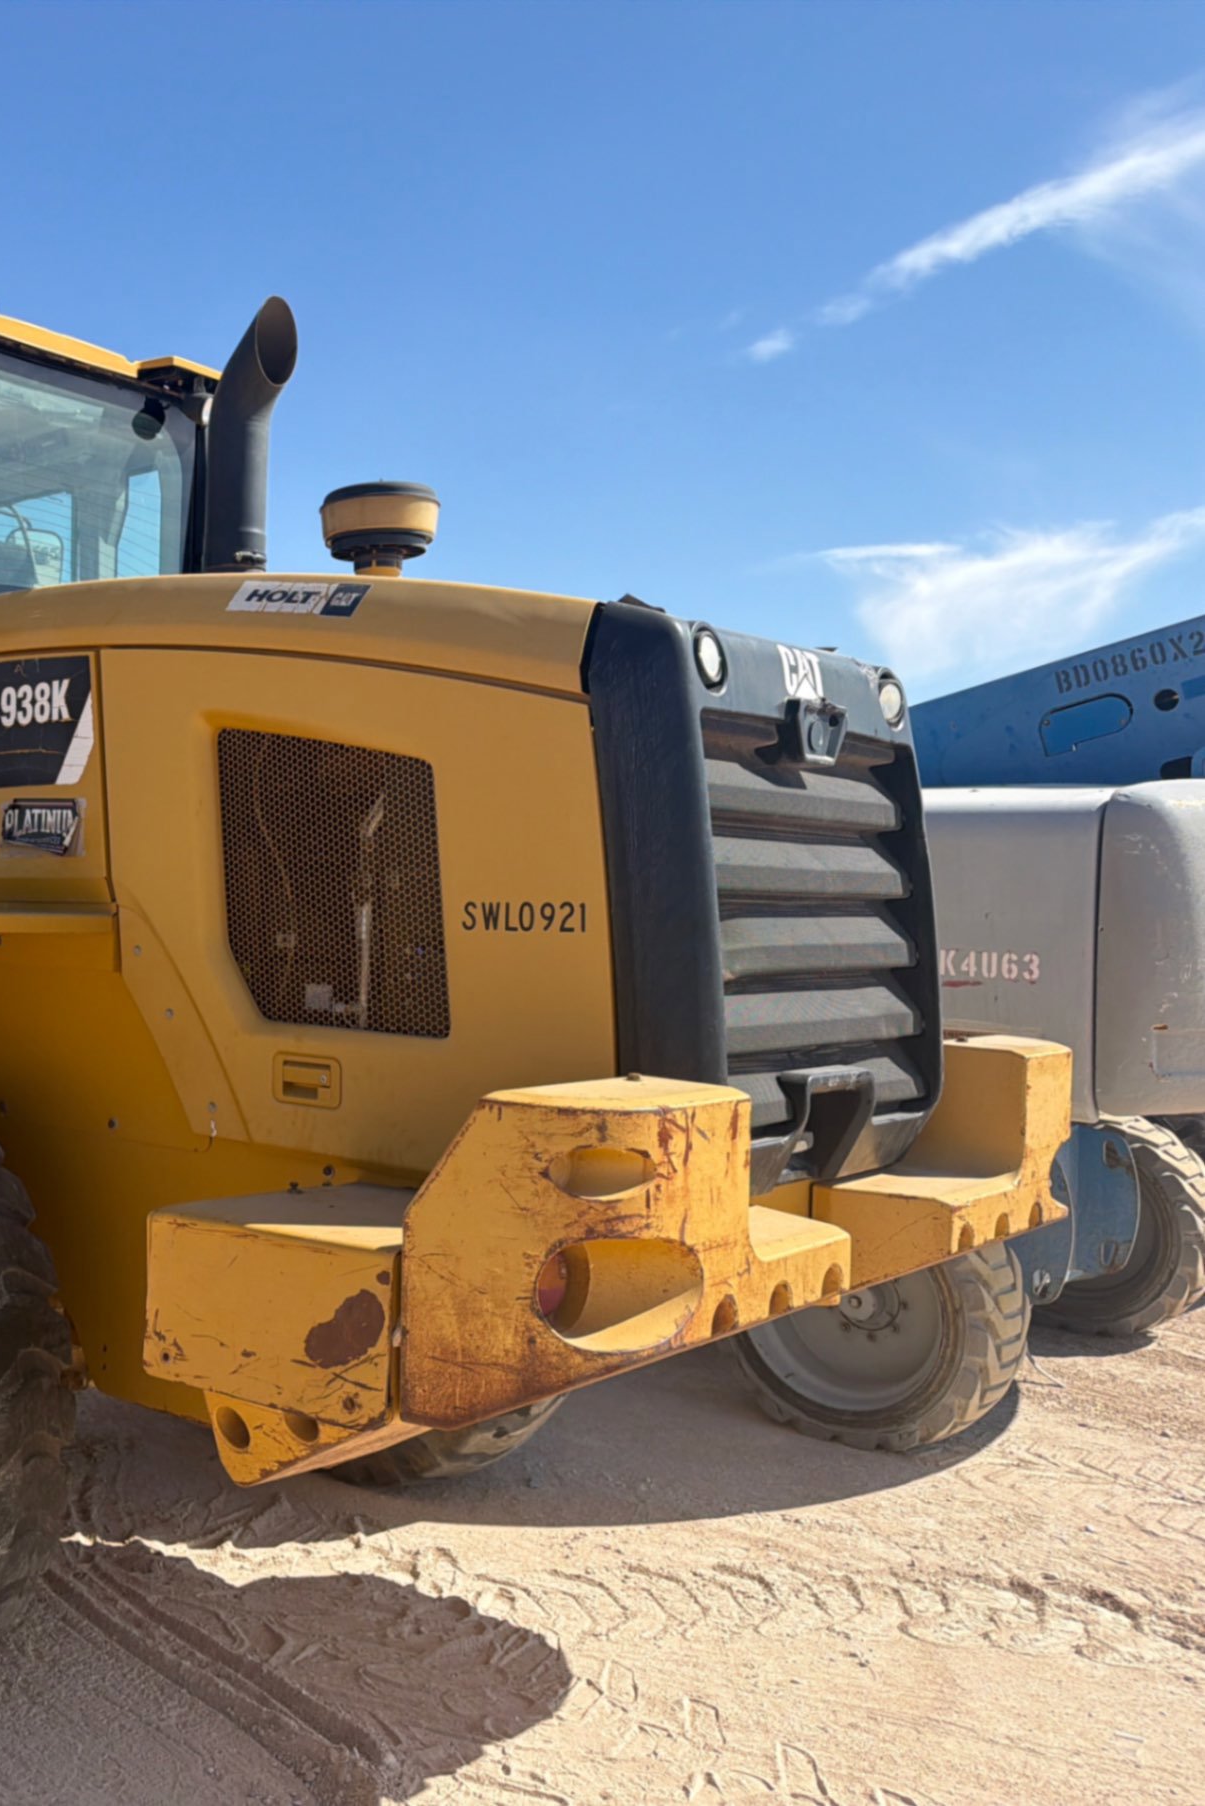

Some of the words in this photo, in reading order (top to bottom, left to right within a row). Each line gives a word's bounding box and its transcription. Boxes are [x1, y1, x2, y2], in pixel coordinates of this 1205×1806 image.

[245, 588, 321, 604] HOLT
[776, 643, 824, 698] CAT
[0, 678, 73, 727] 938K
[939, 949, 1040, 979] K4U63
